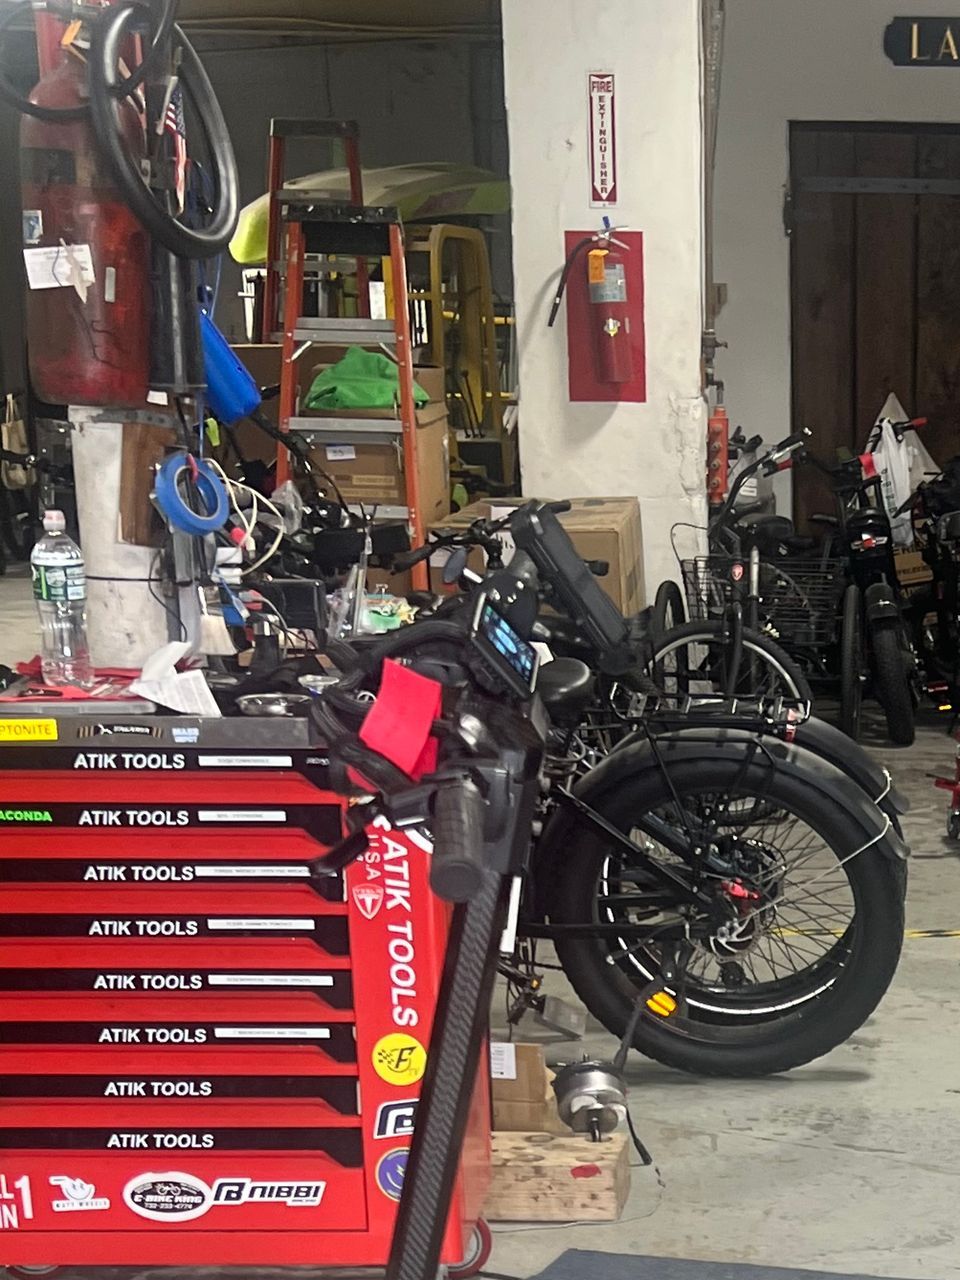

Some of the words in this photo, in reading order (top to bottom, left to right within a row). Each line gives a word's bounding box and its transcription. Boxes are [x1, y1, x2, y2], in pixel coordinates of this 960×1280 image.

[591, 80, 613, 93] FIRE
[598, 95, 608, 194] EXTINGUISHER
[73, 753, 117, 769] ATIK
[121, 753, 186, 769] TOOLS
[78, 810, 122, 826] ATIK
[125, 810, 190, 826] TOOLS
[83, 865, 126, 881] ATIK
[131, 865, 194, 881] TOOLS
[381, 835, 412, 913] ATIK
[88, 920, 131, 936] ATIK
[135, 920, 198, 936] TOOLS
[93, 974, 136, 990] ATIK
[140, 974, 203, 990] TOOLS
[387, 920, 419, 1028] TOOLS
[98, 1028, 141, 1043] ATIK
[145, 1028, 207, 1043] TOOLS
[104, 1081, 146, 1097] ATIK
[150, 1081, 212, 1097] TOOLS
[107, 1133, 149, 1149] ATIK
[153, 1133, 215, 1149] TOOLS
[14, 1175, 34, 1220] 1
[248, 1185, 322, 1198] NIBBI
